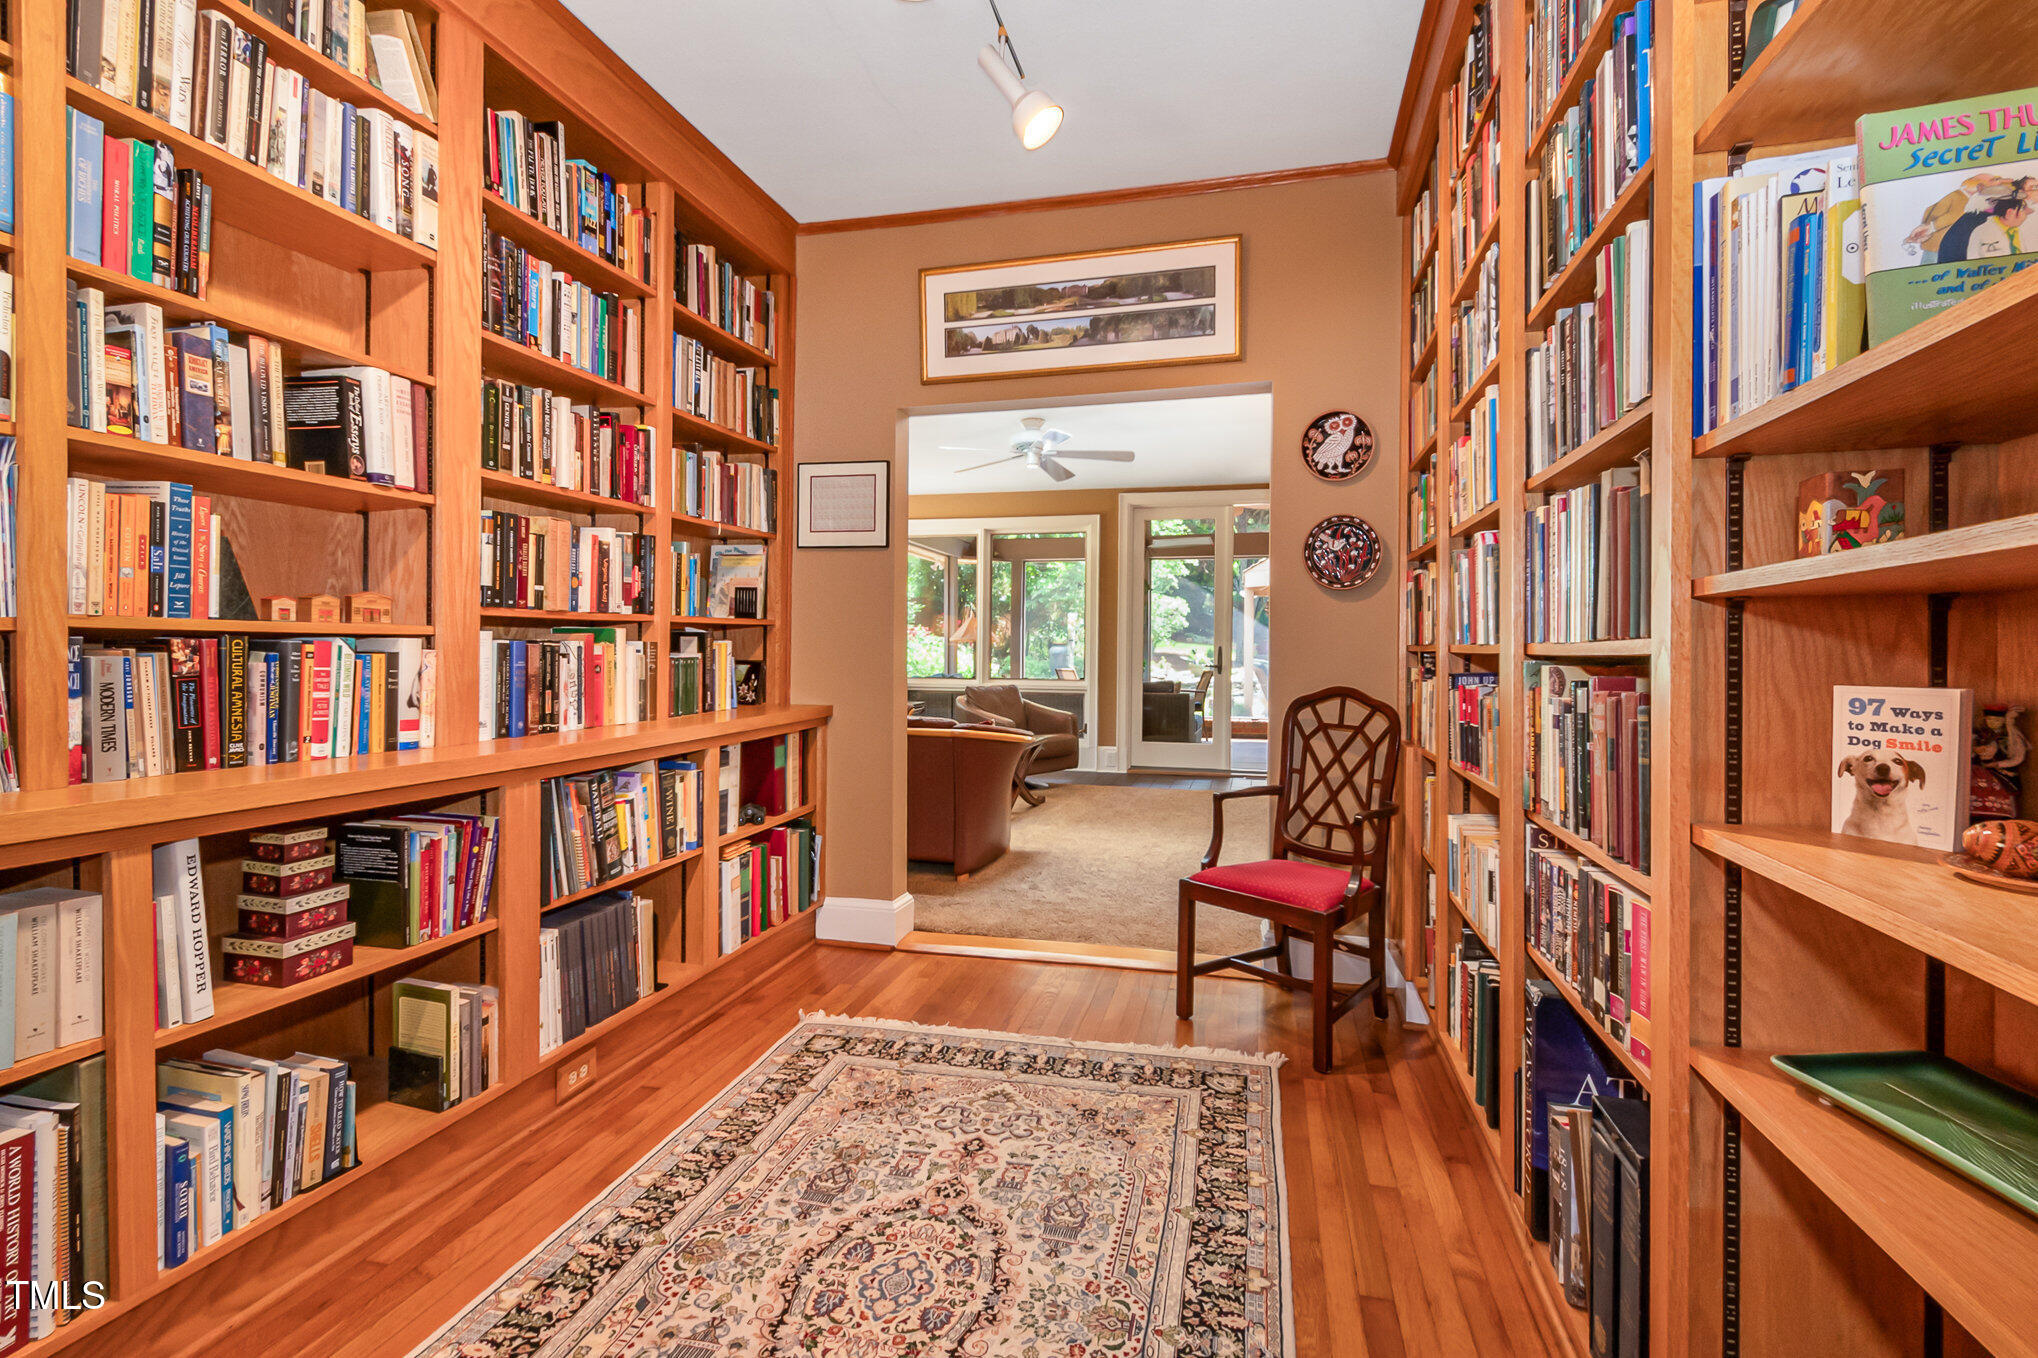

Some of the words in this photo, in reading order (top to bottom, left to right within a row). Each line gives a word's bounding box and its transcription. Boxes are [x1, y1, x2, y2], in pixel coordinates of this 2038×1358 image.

[219, 40, 229, 77] TERROR
[178, 76, 192, 104] Wars
[1879, 113, 1976, 150] JAMES
[527, 149, 537, 176] FLUTE
[113, 179, 121, 202] MORAL
[401, 159, 411, 198] SONG
[527, 176, 537, 197] BOOK
[112, 204, 120, 236] POLITICS
[190, 204, 199, 269] NEOLIBERALISM
[182, 243, 190, 272] COUNTRY
[1931, 269, 1951, 283] of
[1936, 281, 1965, 295] and
[1970, 279, 1992, 292] of
[530, 278, 538, 309] Opera
[214, 340, 224, 375] BIBLICAL
[259, 357, 268, 390] BELOVED
[216, 375, 225, 407] WORLD
[260, 390, 269, 415] VISION
[353, 386, 361, 397] The
[353, 396, 361, 415] Oxford
[347, 412, 363, 455] Essays
[77, 483, 87, 524] LINCOLN
[123, 527, 132, 562] COTTON
[152, 549, 163, 570] Salt
[197, 542, 208, 562] Story
[169, 581, 190, 589] Lepore
[230, 639, 244, 690] CULTURAL
[342, 653, 353, 683] BECOMING
[125, 674, 134, 703] JOHNSON
[342, 683, 352, 698] WILD
[1458, 676, 1479, 686] JOHN
[99, 681, 115, 722] MODERN
[181, 692, 190, 725] Imagination
[188, 692, 197, 715] Pleasures
[231, 691, 244, 742] AMNESIA
[1847, 697, 1887, 717] 97
[1889, 707, 1944, 723] Ways
[100, 723, 117, 753] TIMES
[1847, 720, 1865, 731] to
[1869, 721, 1926, 736] Make
[1930, 727, 1943, 737] a
[1847, 735, 1883, 751] Dog
[1885, 737, 1943, 753] Smile
[590, 782, 604, 842] BASEBALL
[664, 788, 675, 826] WINE
[186, 854, 202, 925] EDWARD
[31, 916, 40, 947] WILLIAM
[1640, 911, 1648, 929] THE
[1640, 930, 1648, 955] FIRST
[31, 949, 40, 997] SHAKESPEARE
[75, 939, 83, 985] SHAKESPEARE
[191, 929, 207, 995] HOPPER
[1640, 957, 1648, 976] MAN
[1640, 976, 1648, 988] IN
[1639, 988, 1648, 1013] ROME
[10, 1146, 23, 1156] A
[208, 1145, 220, 1164] Bird
[223, 1122, 232, 1163] WATCHING
[308, 1122, 323, 1164] SHELLS
[8, 1154, 22, 1206] WORLD
[208, 1165, 220, 1204] Behavior
[223, 1163, 232, 1186] BIRDS
[179, 1180, 188, 1219] BIRDS
[5, 1206, 21, 1267] HISTORY
